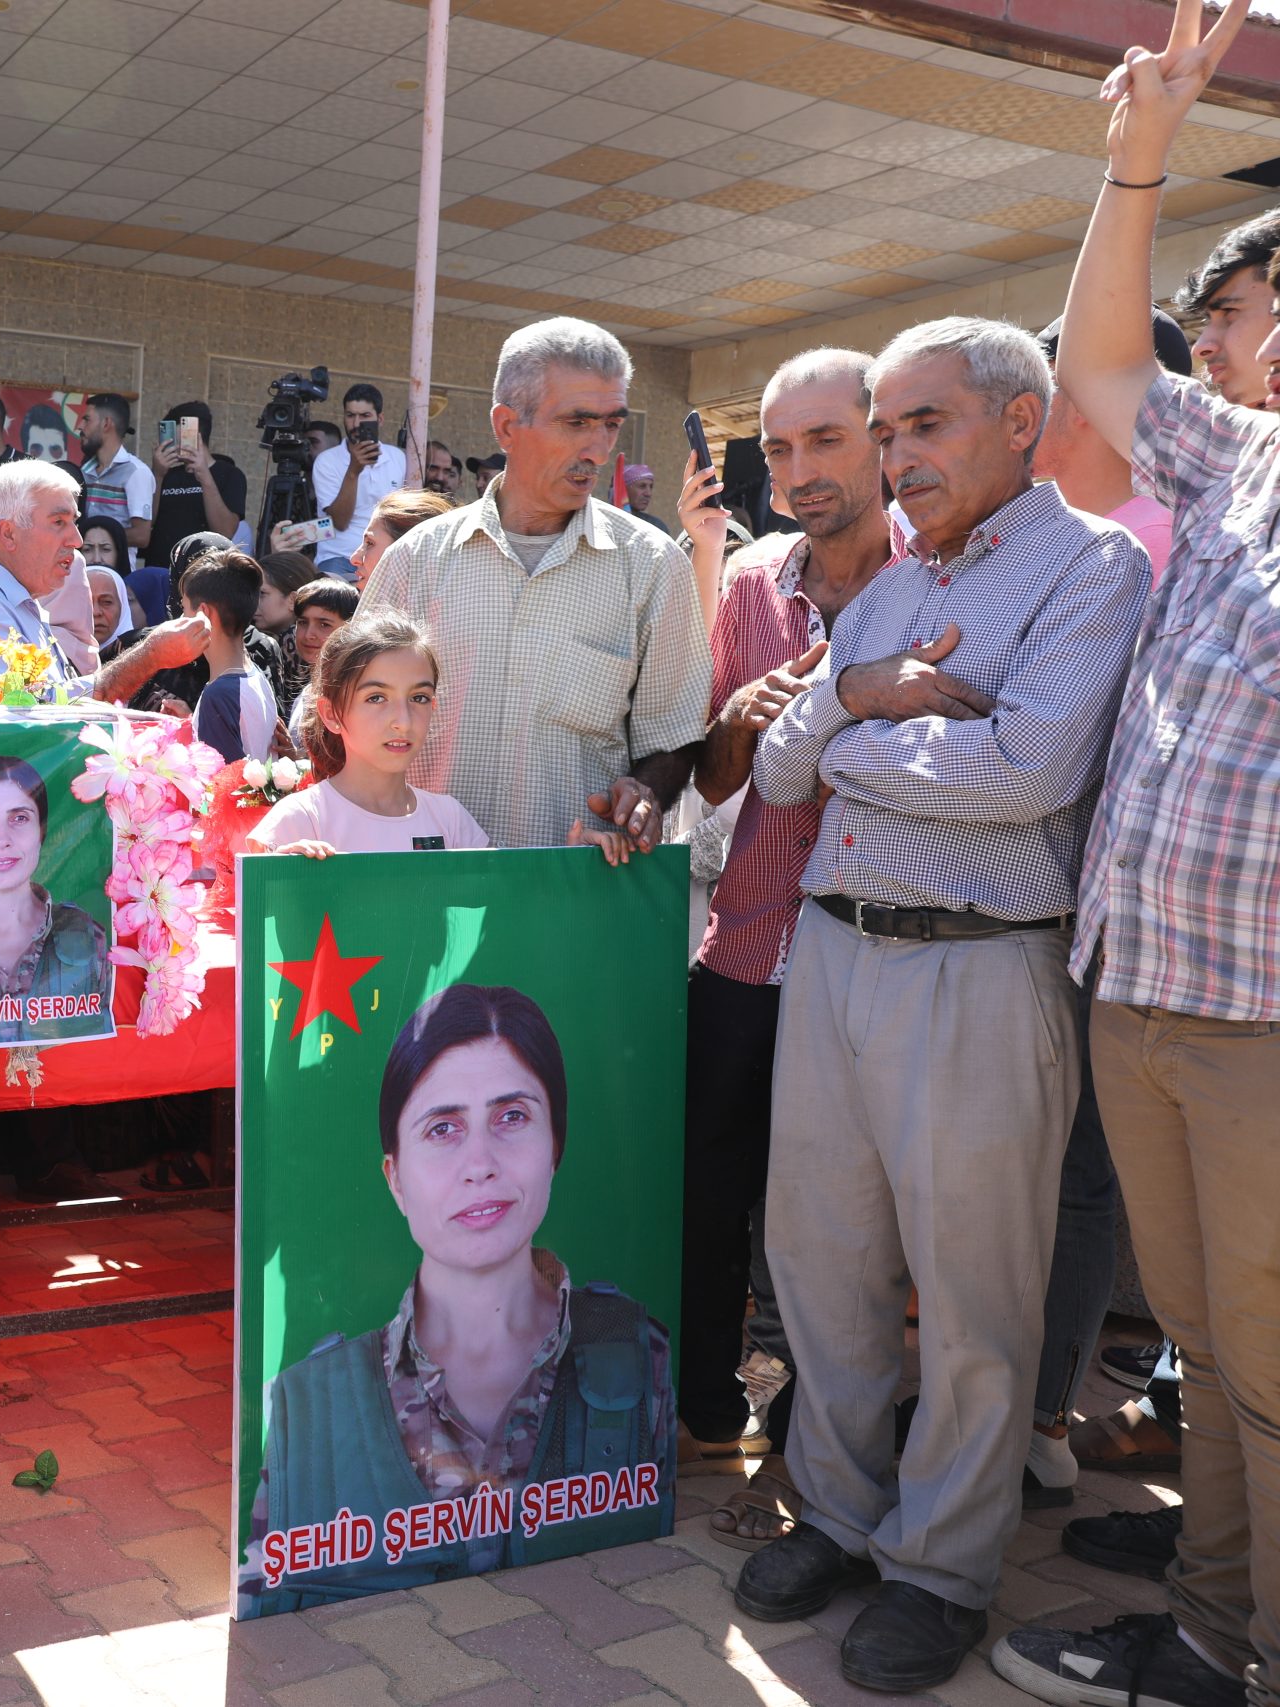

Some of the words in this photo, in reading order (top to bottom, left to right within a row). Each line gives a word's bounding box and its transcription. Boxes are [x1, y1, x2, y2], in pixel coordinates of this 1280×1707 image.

[27, 994, 101, 1024] ŞERDAR
[269, 998, 283, 1021] Y
[370, 989, 380, 1010] J
[320, 1033, 334, 1055] P
[263, 1509, 374, 1585] ŞEHÎD
[385, 1484, 512, 1562] ŞERVÎN
[522, 1464, 659, 1536] ŞERDAR
